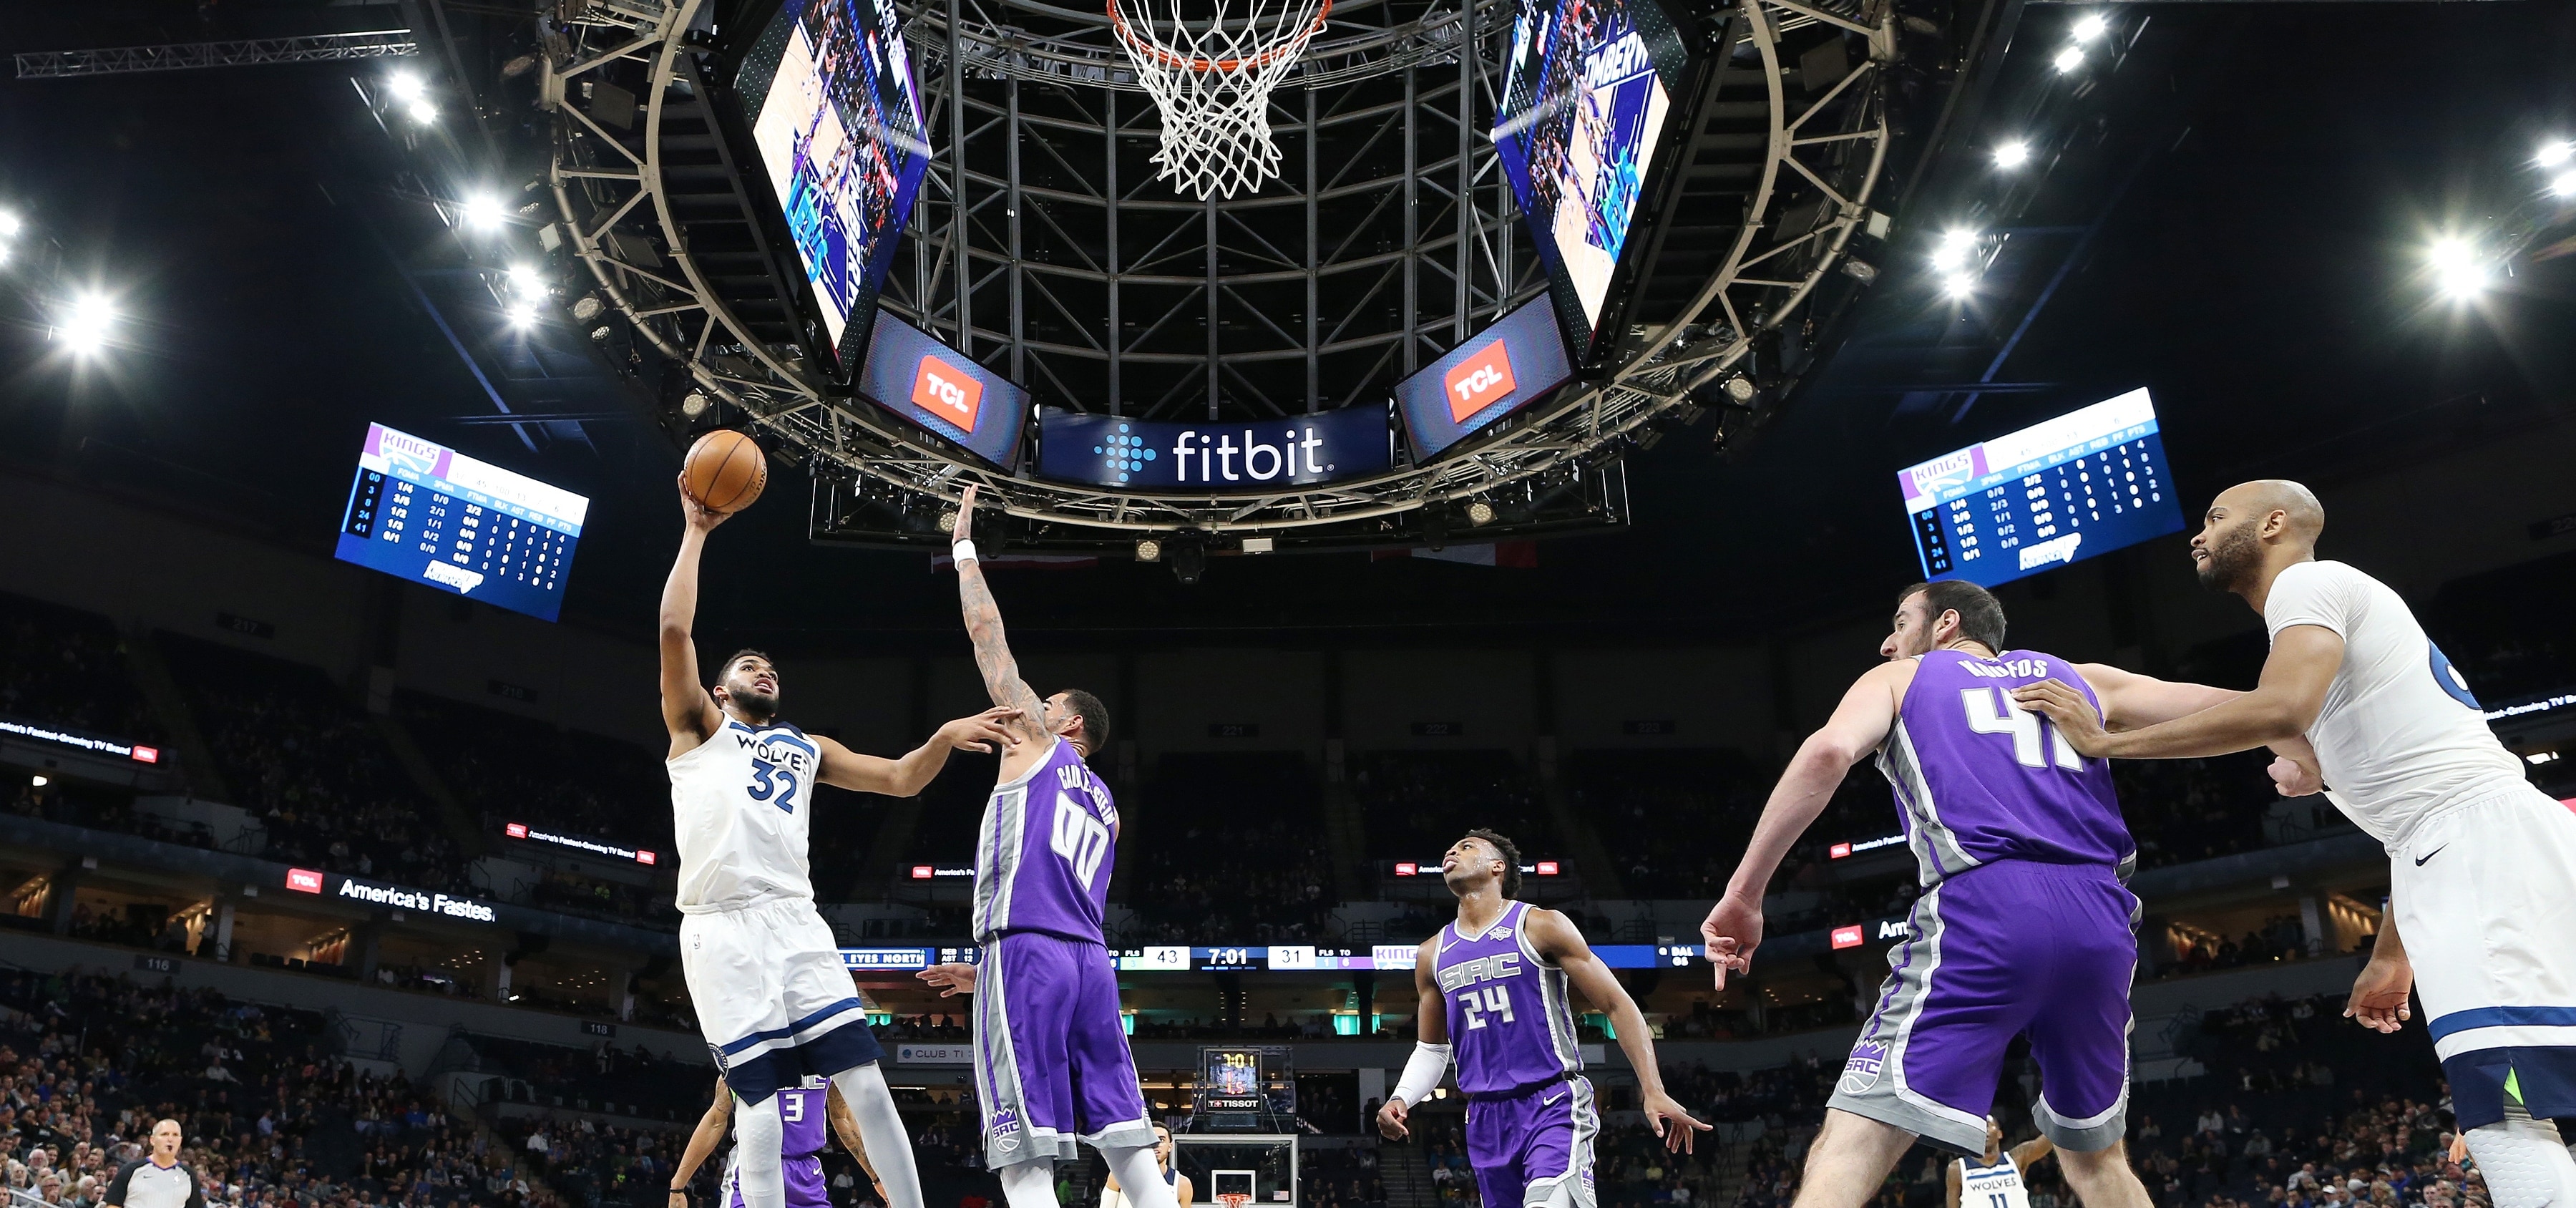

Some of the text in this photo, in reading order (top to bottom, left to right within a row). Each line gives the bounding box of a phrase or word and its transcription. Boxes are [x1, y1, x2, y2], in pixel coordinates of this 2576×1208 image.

[1455, 363, 1502, 401] TCL
[927, 373, 969, 413] TCL
[384, 432, 436, 459] KINGS
[1172, 428, 1323, 482] fitbit
[1916, 453, 1968, 480] KINGS
[1987, 486, 2005, 499] 0/0
[369, 472, 381, 483] 00
[397, 482, 414, 494] 1/4
[433, 493, 449, 505] 0/0
[466, 504, 483, 516] 2/2
[495, 513, 502, 523] 1
[530, 525, 537, 534] 0
[545, 530, 552, 539] 1
[558, 535, 565, 544] 4
[1990, 499, 2009, 511] 2/3
[368, 485, 375, 495] 3
[429, 505, 446, 517] 2/3
[492, 525, 499, 535] 0
[527, 537, 534, 546] 0
[542, 541, 549, 551] 1
[555, 546, 562, 555] 8
[1956, 523, 1975, 536] 1/2
[1994, 511, 2011, 524] 1/1
[391, 506, 408, 519] 1/2
[427, 518, 442, 530] 1/1
[488, 537, 495, 546] 0
[505, 542, 512, 552] 1
[525, 549, 530, 557] 1
[552, 558, 560, 567] 3
[1997, 524, 2016, 536] 0/2
[358, 510, 370, 520] 24
[387, 518, 404, 531] 1/3
[423, 530, 439, 542] 0/2
[485, 549, 492, 558] 0
[522, 560, 527, 570] 1
[550, 570, 557, 579] 2
[2001, 536, 2019, 549] 0/0
[355, 522, 366, 532] 41
[419, 542, 436, 554] 0/0
[482, 561, 489, 570] 0
[499, 567, 506, 576] 1
[517, 572, 525, 581] 3
[547, 581, 553, 590] 0
[2549, 696, 2565, 706] TV
[1222, 726, 1243, 736] 221
[94, 740, 107, 750] TV
[747, 758, 797, 814] 32
[1050, 790, 1110, 893] 00
[608, 847, 618, 855] TV
[292, 874, 496, 922] TCL America's Fastes
[1835, 932, 1858, 943] TCL
[850, 954, 879, 963] EYES
[883, 954, 924, 963] NORTH
[1157, 950, 1177, 963] 43
[1208, 948, 1247, 965] 7:01
[1282, 950, 1301, 963] 31
[1671, 946, 1694, 956] DAL
[147, 958, 170, 971] 116
[1324, 958, 1330, 967] 1
[1438, 952, 1522, 993] SAC
[1458, 984, 1515, 1030] 24
[590, 1023, 608, 1035] 118
[1223, 1053, 1255, 1068] 7:01
[1845, 1059, 1880, 1075] SAC
[784, 1093, 804, 1121] 3
[992, 1121, 1020, 1139] SAC
[1970, 1177, 2016, 1192] WOLVES
[1989, 1193, 2009, 1208] 11
